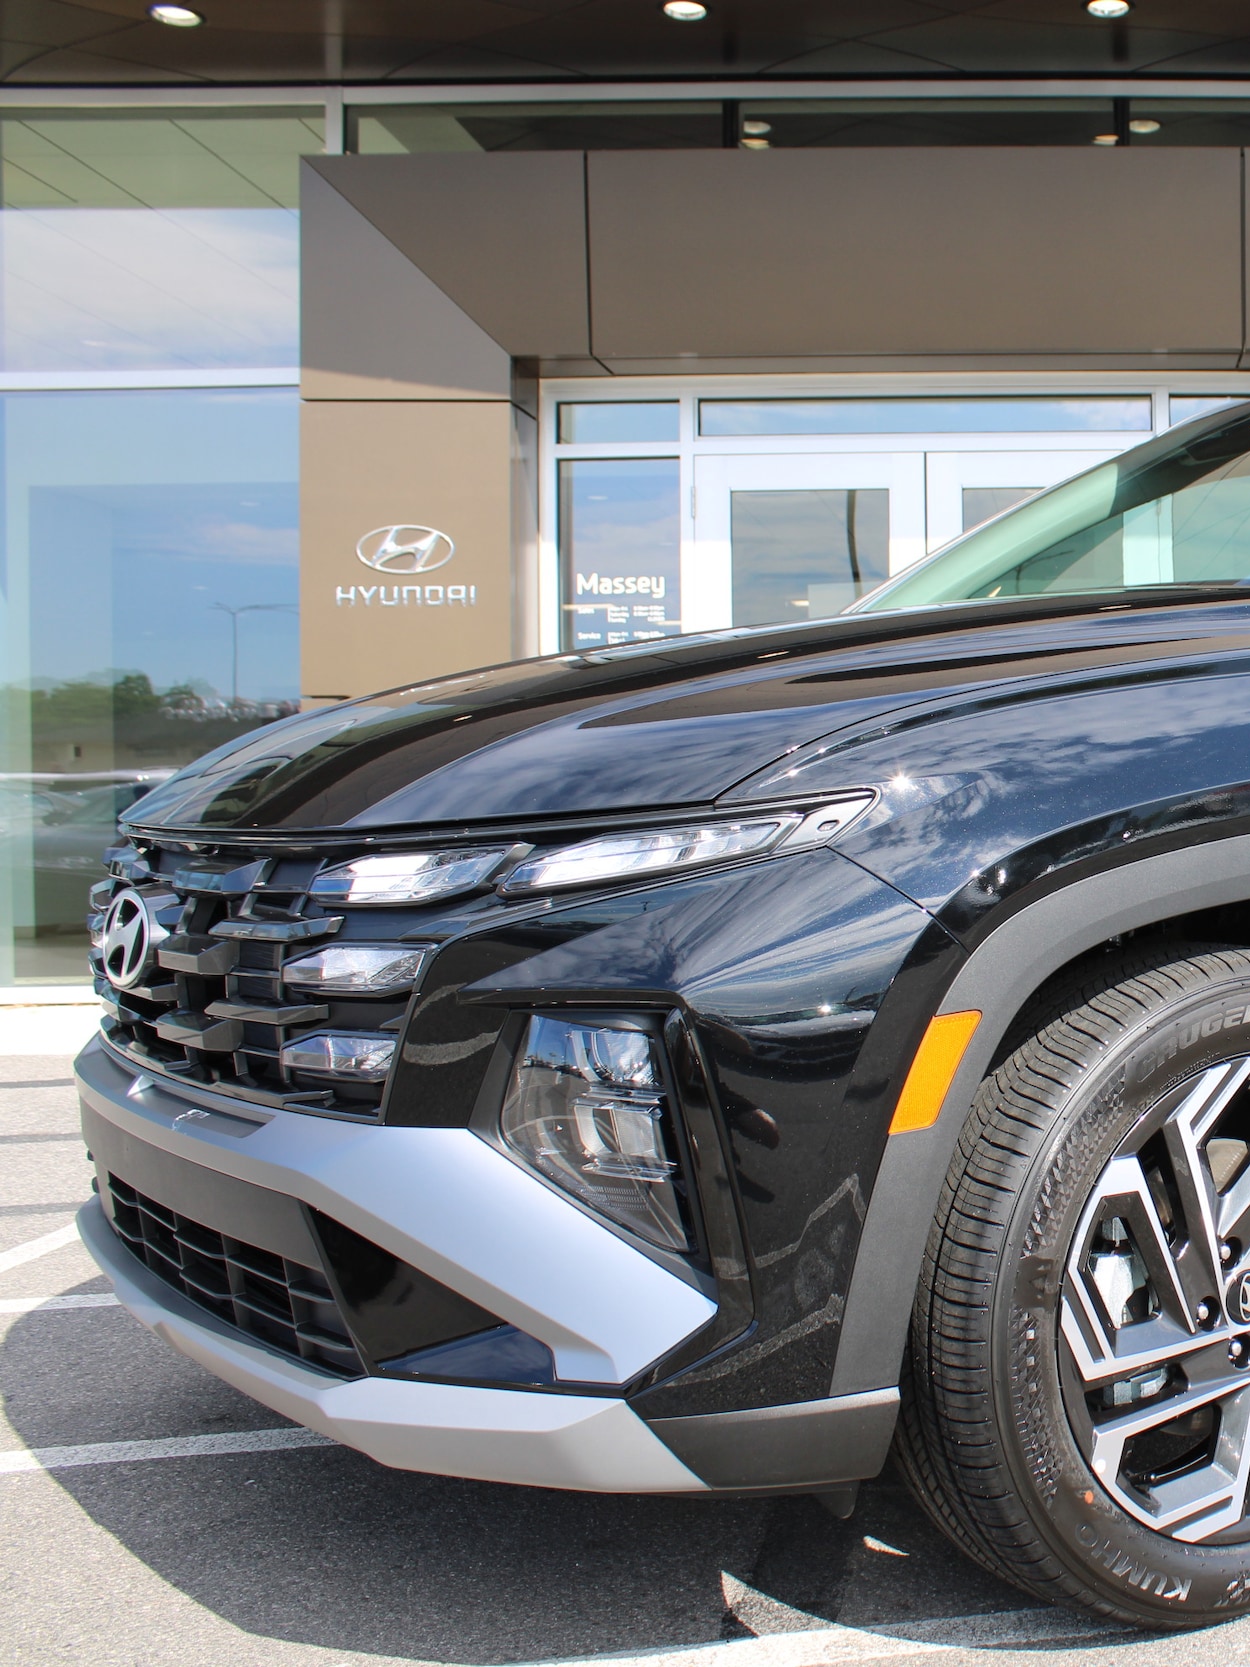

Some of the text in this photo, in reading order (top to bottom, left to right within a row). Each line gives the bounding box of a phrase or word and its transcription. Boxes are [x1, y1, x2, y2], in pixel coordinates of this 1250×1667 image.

[335, 584, 476, 607] HYUNDAI
[576, 572, 665, 599] Massey
[1075, 1522, 1193, 1602] KUMHO
